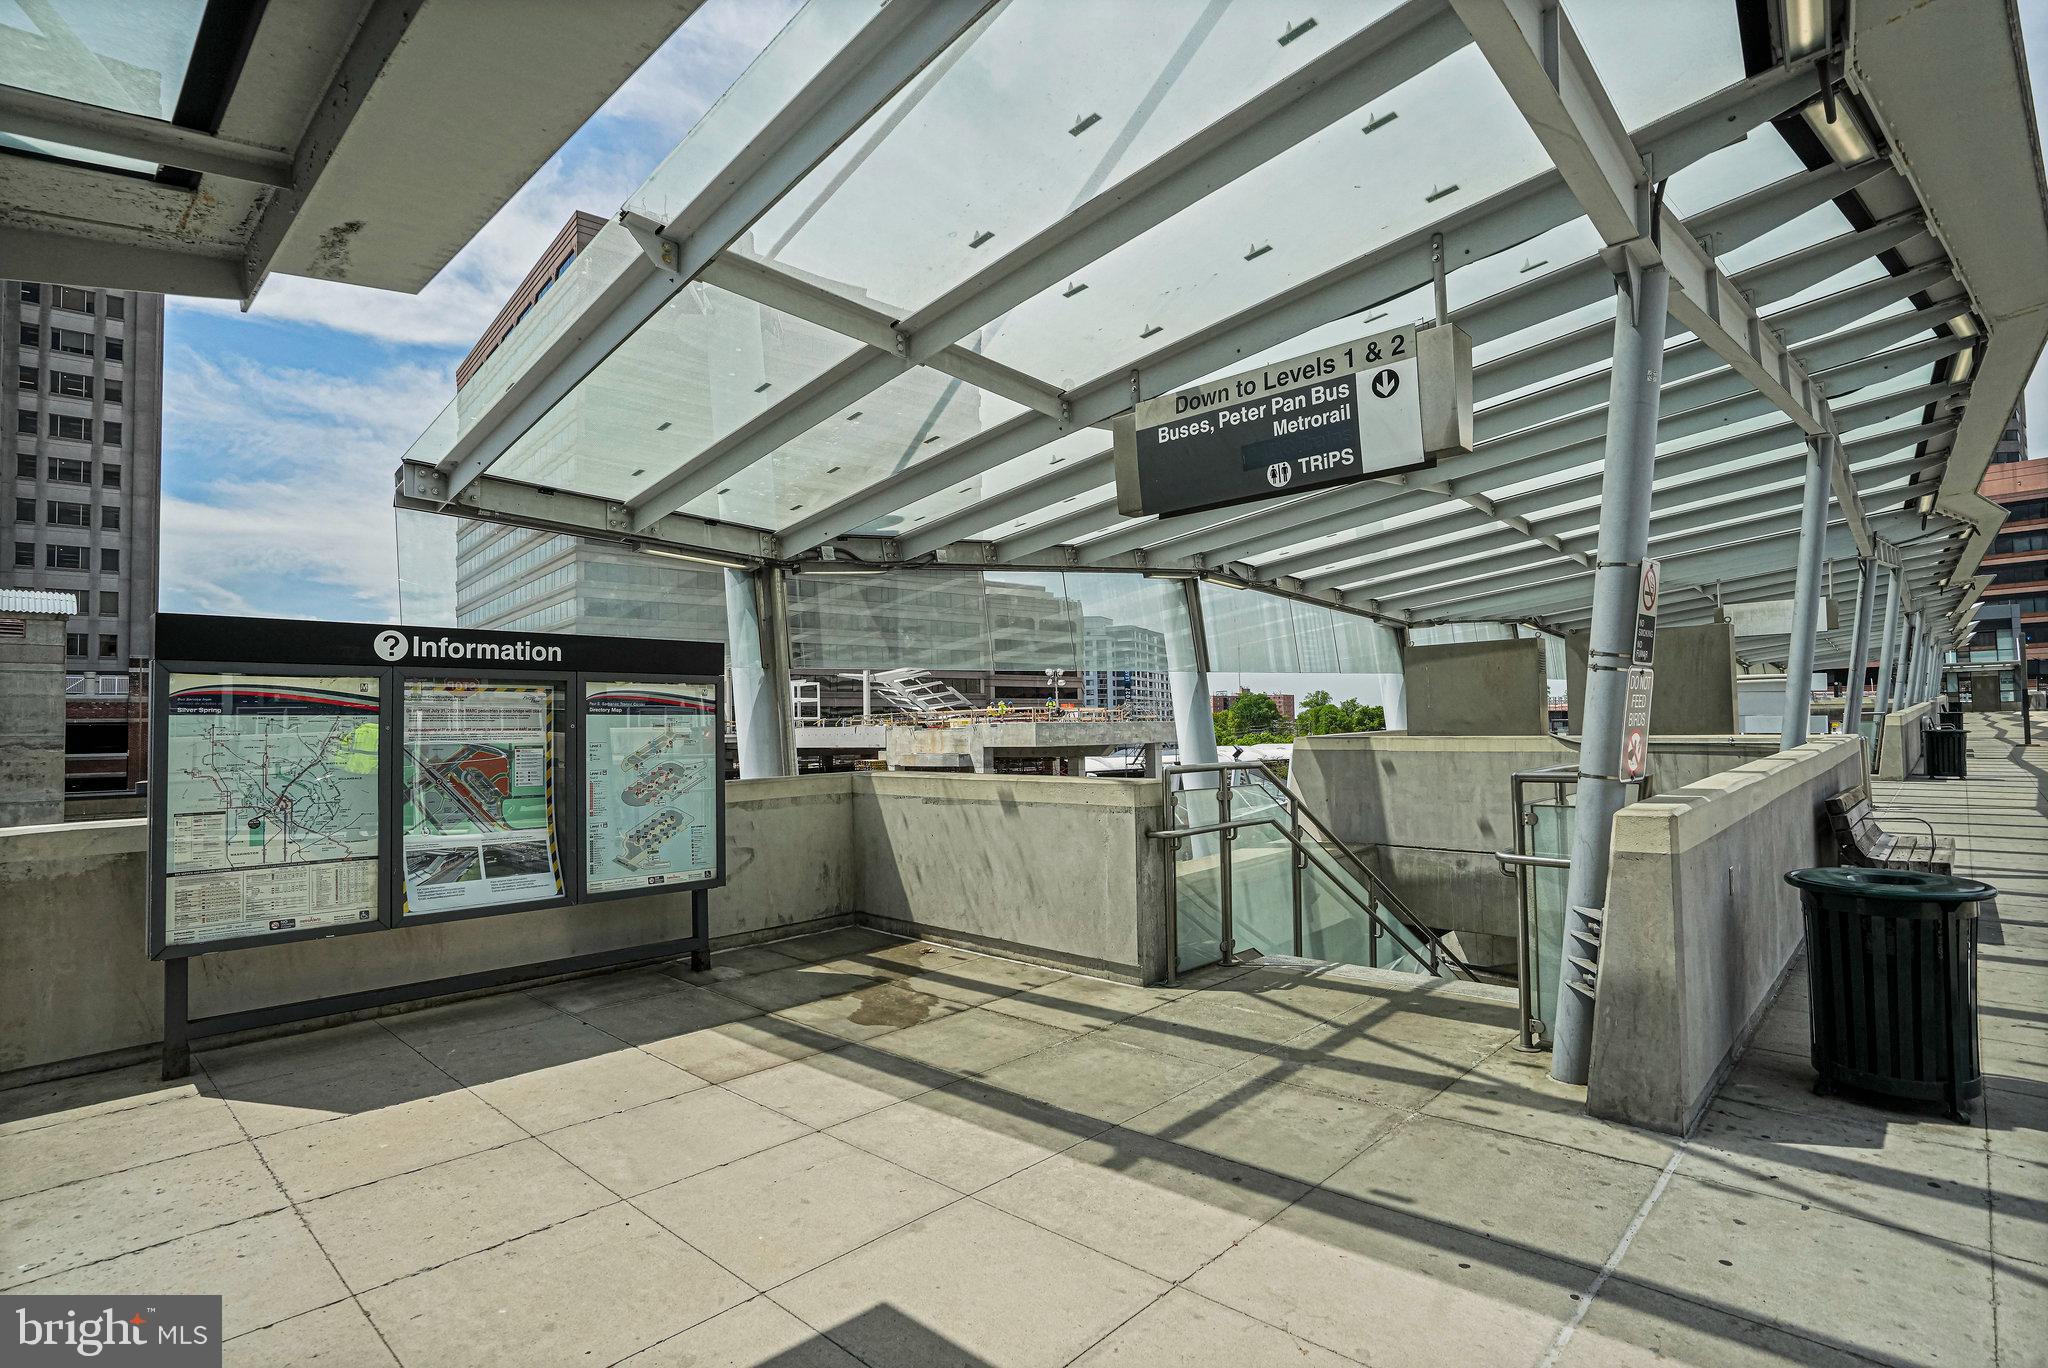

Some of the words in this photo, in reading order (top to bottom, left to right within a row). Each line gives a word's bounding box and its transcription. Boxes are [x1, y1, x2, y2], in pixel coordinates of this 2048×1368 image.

[1174, 387, 1229, 414] Down
[1235, 380, 1257, 398] to
[1263, 357, 1336, 391] Levels
[1343, 347, 1354, 368] 1
[1365, 341, 1383, 363] &
[1391, 334, 1406, 357] 2
[1157, 420, 1215, 444] Buses,
[1218, 404, 1267, 429] Peter
[1271, 391, 1307, 416] Pan
[1310, 383, 1350, 406] Bus
[1272, 403, 1351, 437] Metrorail
[1297, 447, 1355, 474] TRiPS
[1638, 628, 1653, 638] SMOKING
[413, 635, 562, 662] Information
[1630, 675, 1640, 690] DO
[1640, 675, 1652, 690] NOT
[1631, 694, 1647, 708] FEED
[1628, 712, 1646, 727] BIRDS
